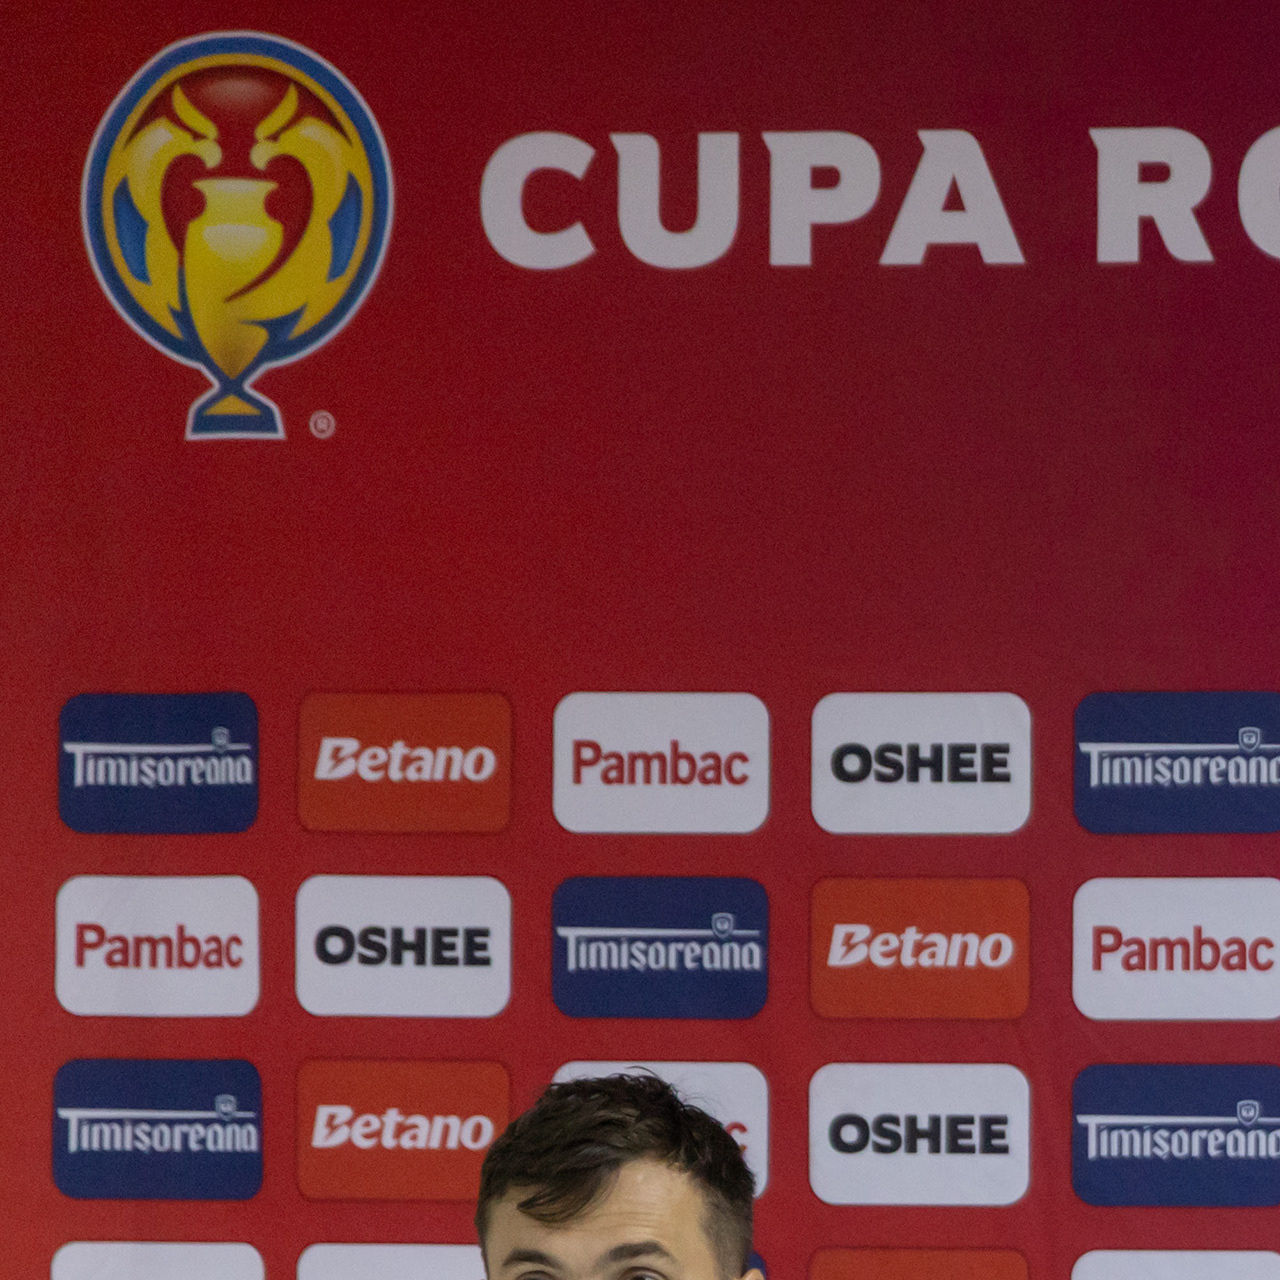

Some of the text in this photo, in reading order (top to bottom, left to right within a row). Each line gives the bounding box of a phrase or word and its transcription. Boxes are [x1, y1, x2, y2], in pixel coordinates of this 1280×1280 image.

[479, 128, 1026, 270] CUPA
[314, 737, 497, 782] Betano
[572, 739, 750, 787] Pambac
[830, 742, 1012, 784] OSHEE
[74, 922, 243, 970] Pambac
[314, 925, 492, 967] OSHEE
[827, 923, 1015, 968] Betano
[1092, 925, 1275, 973] Pambac
[311, 1105, 495, 1151] Betano
[828, 1113, 1010, 1155] OSHEE
